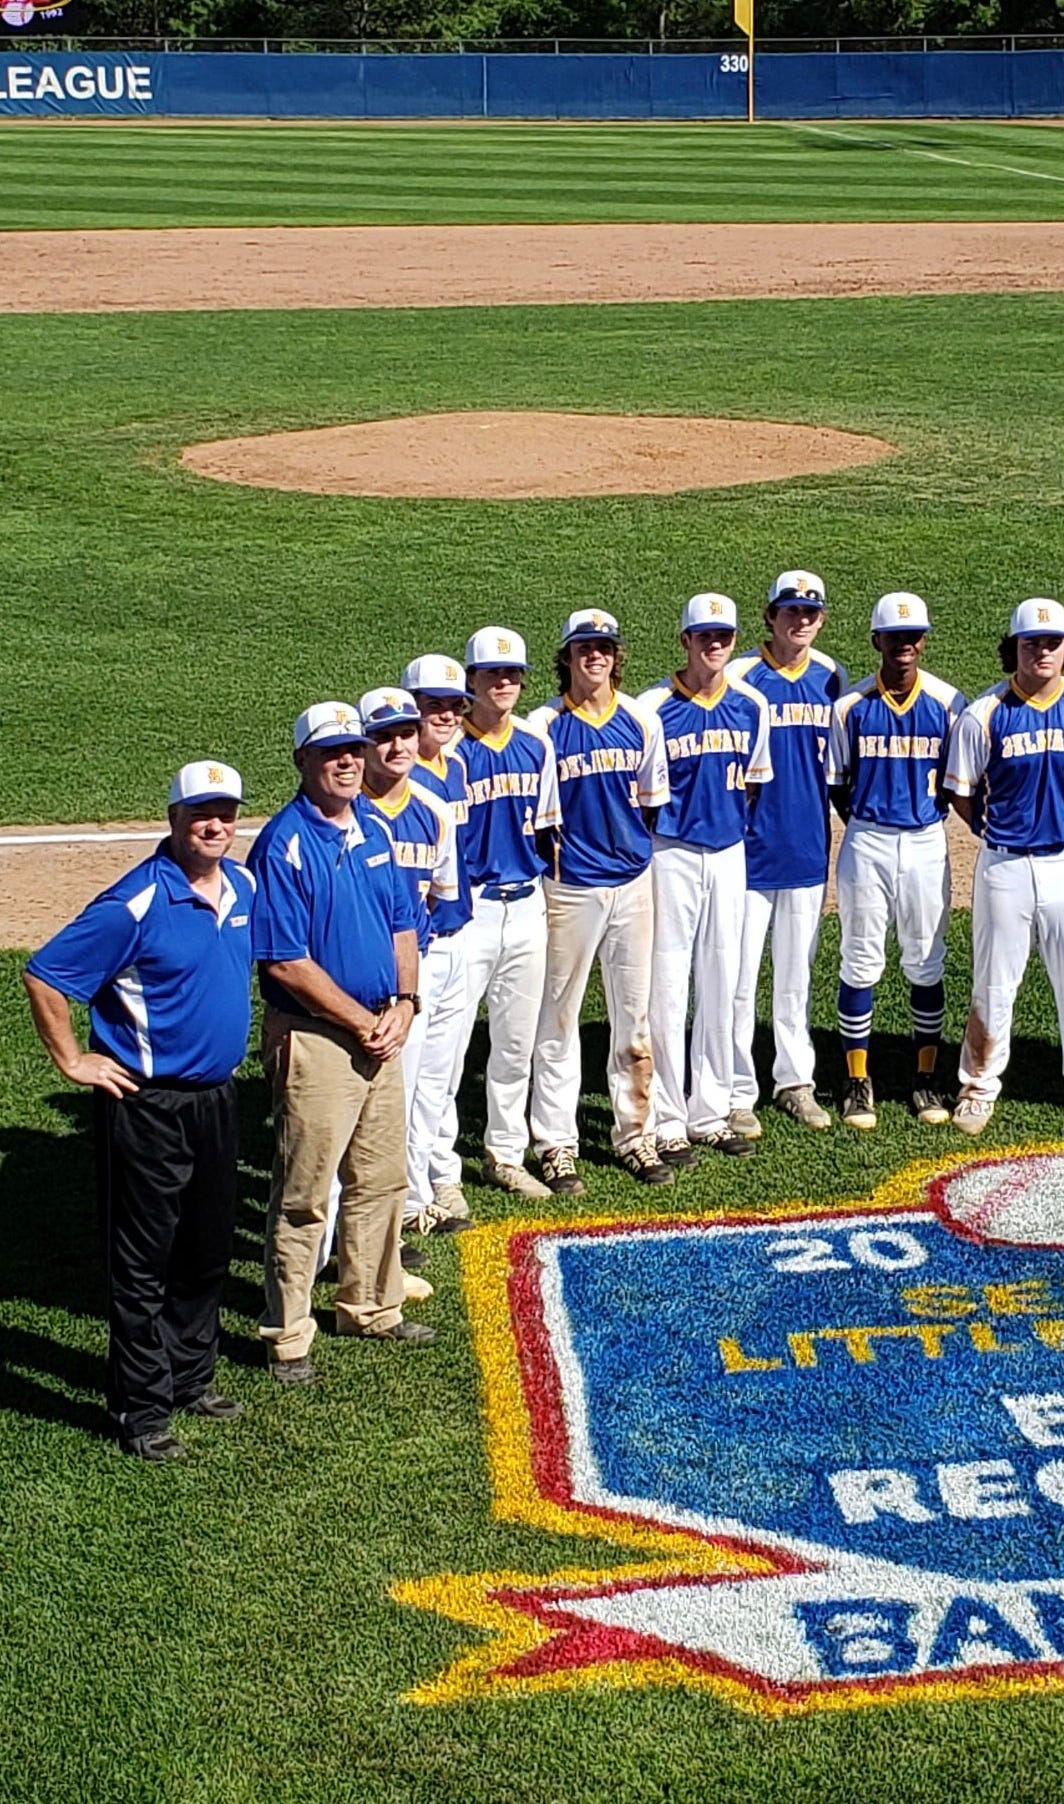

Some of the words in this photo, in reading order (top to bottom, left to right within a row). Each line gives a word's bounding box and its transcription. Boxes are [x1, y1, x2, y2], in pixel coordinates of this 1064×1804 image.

[720, 54, 748, 72] 330
[858, 736, 943, 758] DELAWARE
[764, 1231, 930, 1274] 20
